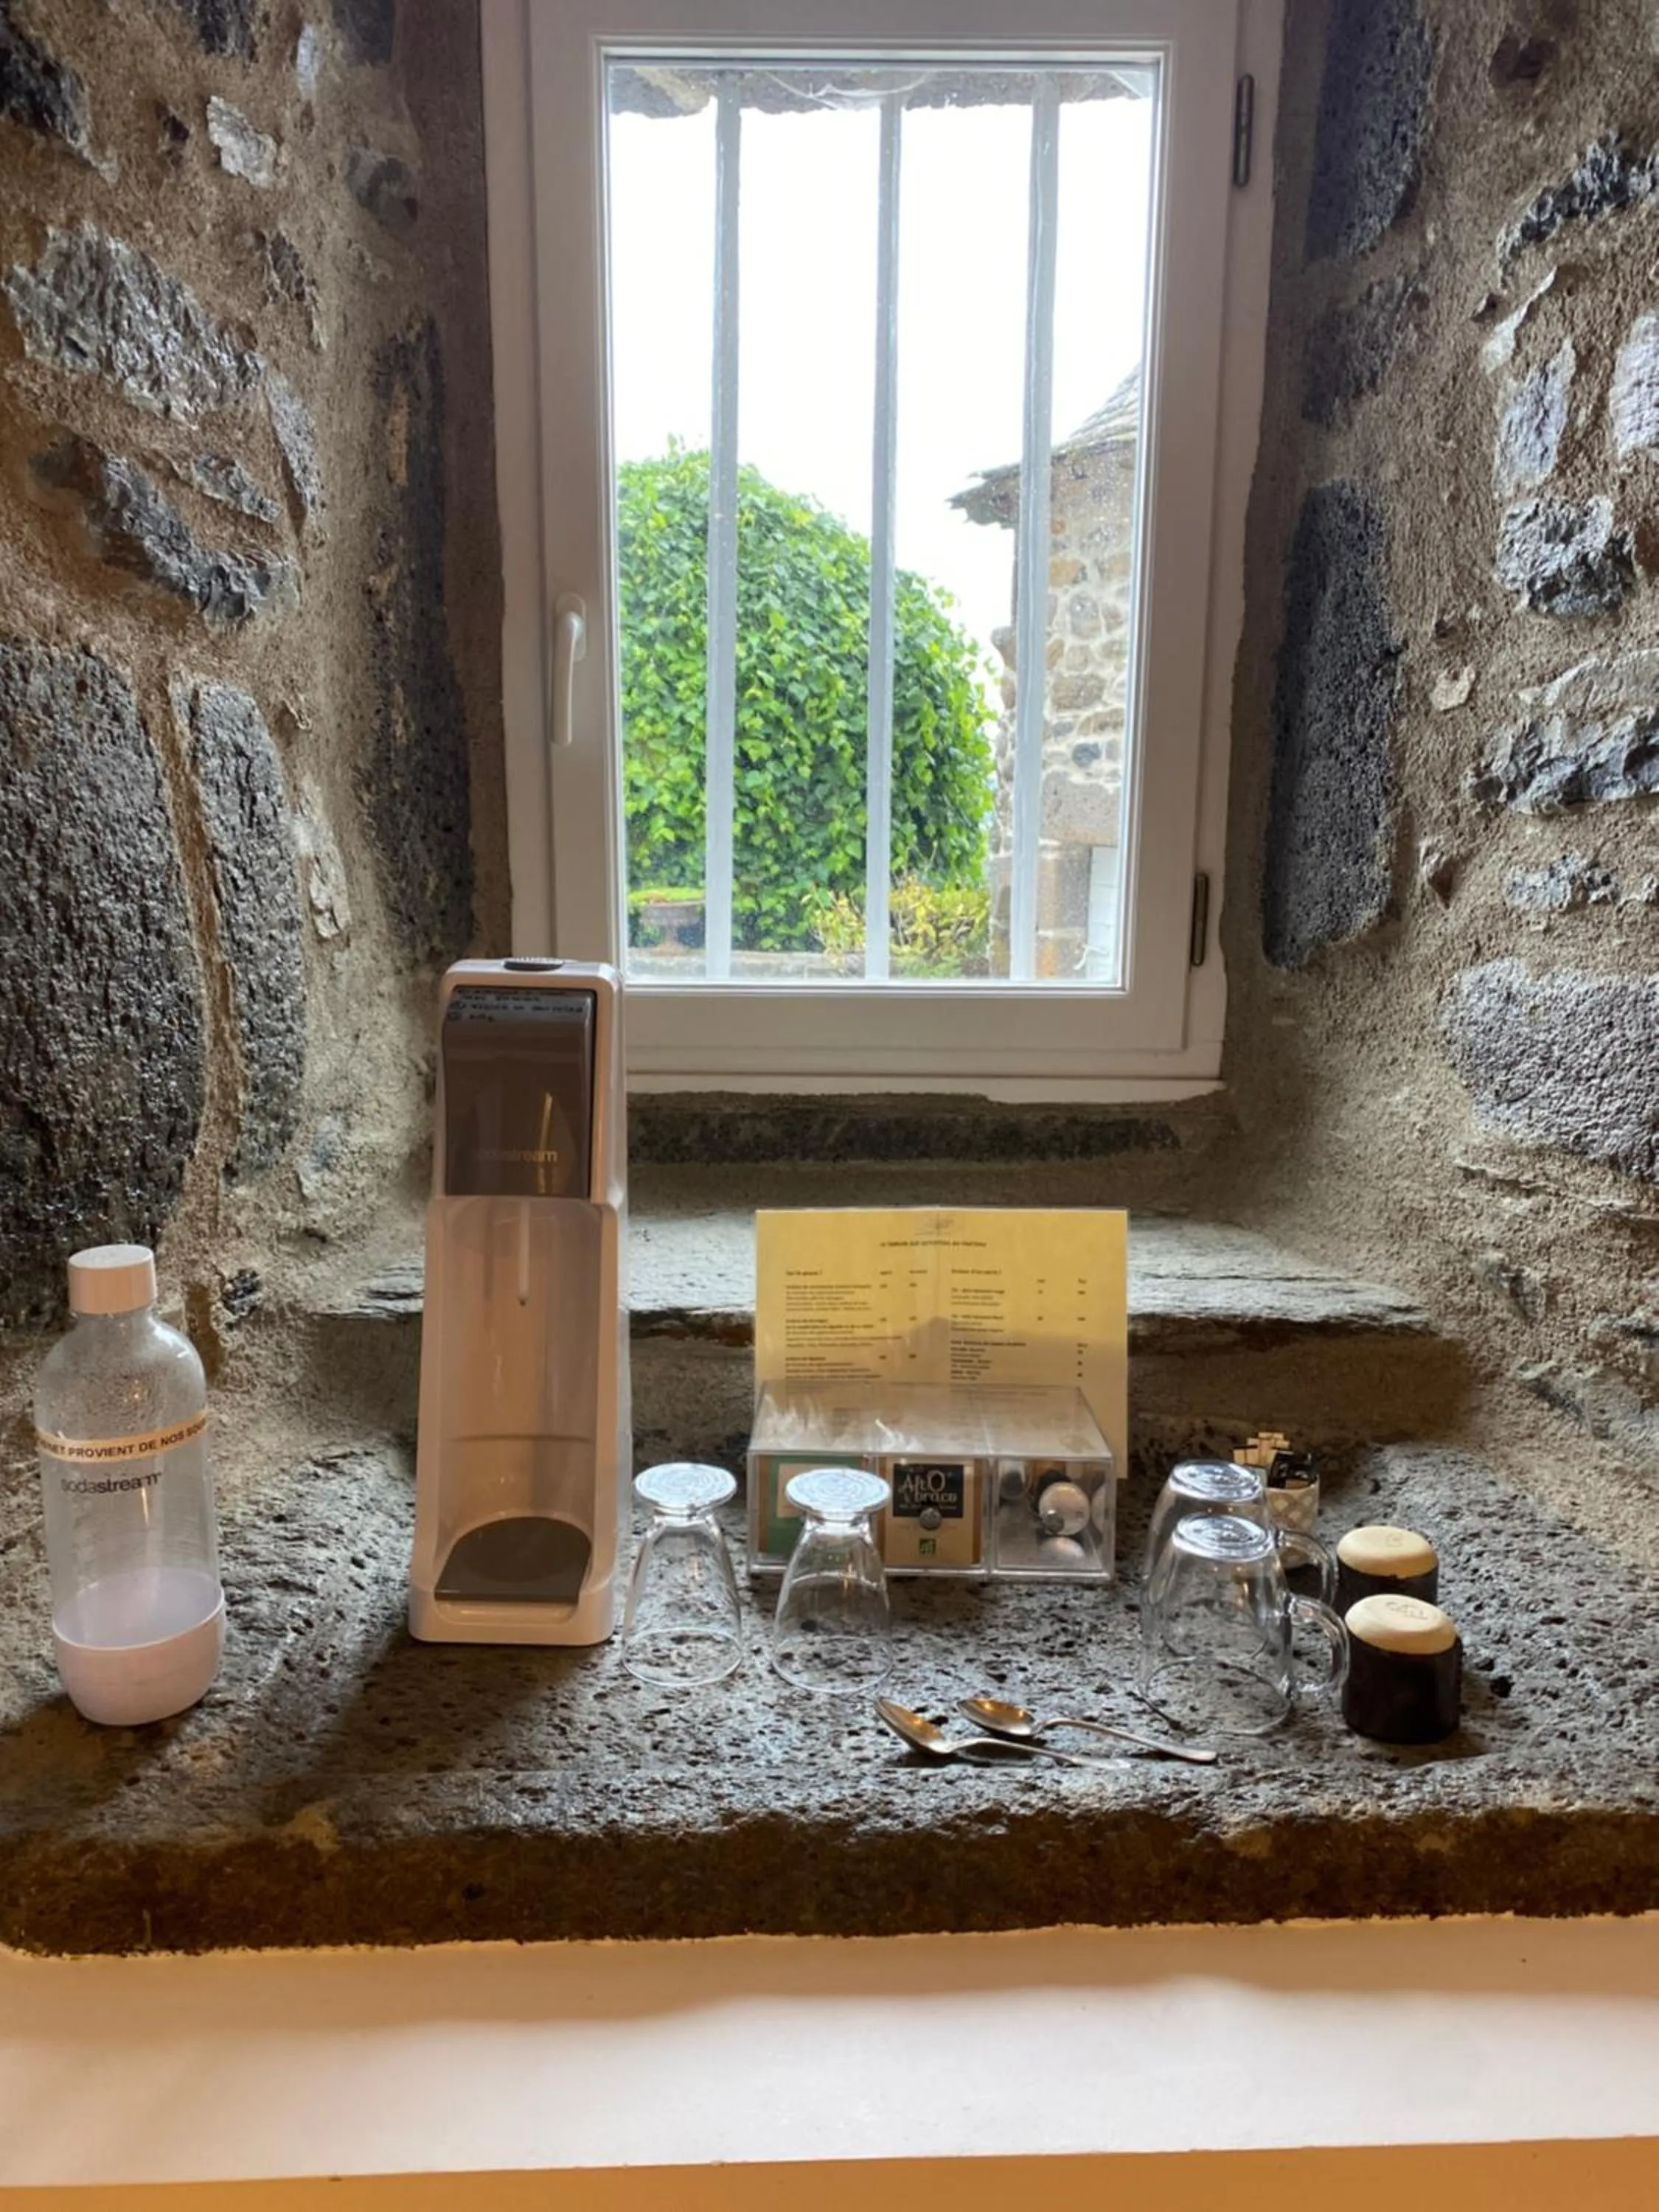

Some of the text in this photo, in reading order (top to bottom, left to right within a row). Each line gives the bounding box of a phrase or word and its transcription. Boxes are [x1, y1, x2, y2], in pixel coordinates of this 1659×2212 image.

[68, 1445, 134, 1458] PROVIENT
[138, 1441, 158, 1453] DE
[160, 1430, 184, 1447] NOS
[60, 1473, 160, 1494] sodastream
